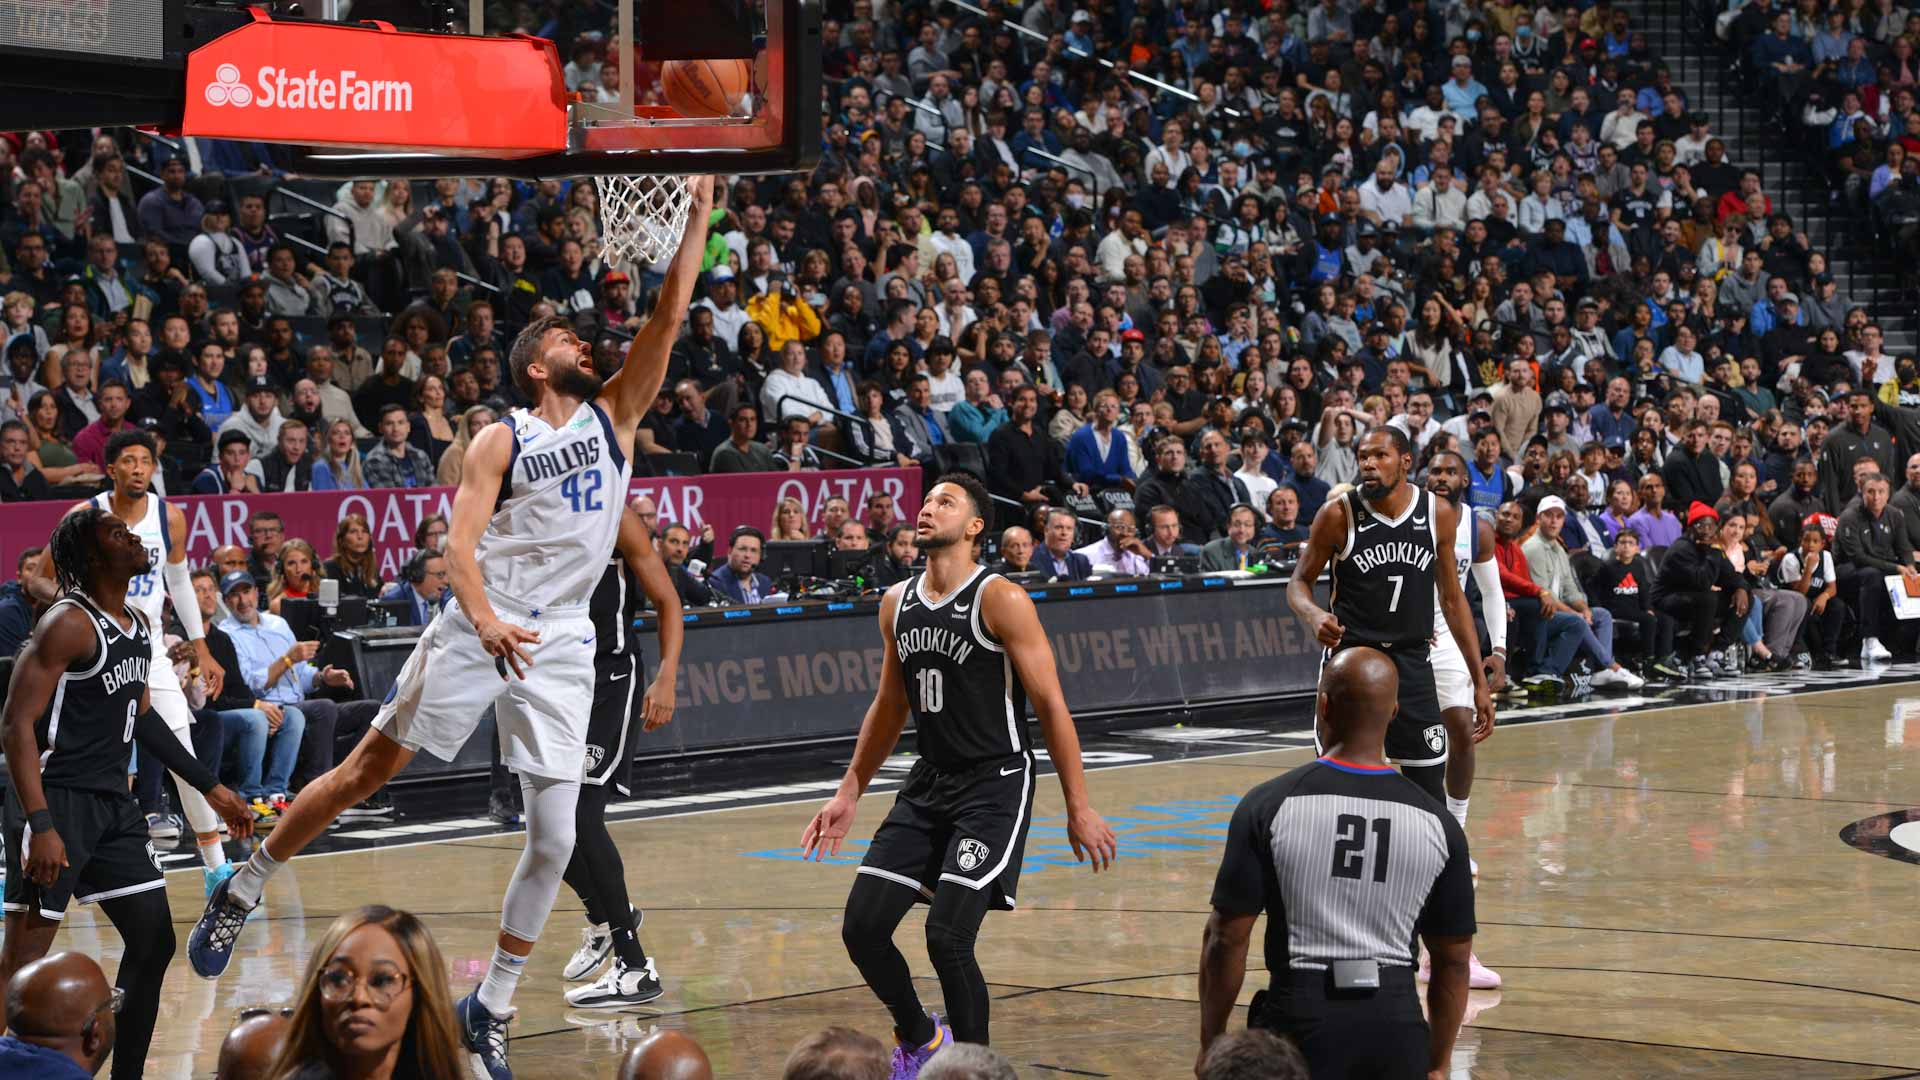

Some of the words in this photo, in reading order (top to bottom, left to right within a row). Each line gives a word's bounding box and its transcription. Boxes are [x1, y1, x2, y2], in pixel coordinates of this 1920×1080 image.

[256, 66, 336, 110] State
[339, 70, 412, 111] Farm
[522, 437, 600, 482] DALLAS
[561, 469, 603, 512] 42
[1353, 542, 1433, 573] BROOKLYN
[1388, 576, 1404, 612] 7
[897, 627, 974, 665] BROOKLYN
[1136, 622, 1227, 667] WITH
[102, 657, 151, 695] BROOKL
[916, 668, 944, 713] 10
[123, 699, 138, 743] 6
[960, 840, 987, 860] NETS
[1331, 813, 1391, 883] 21
